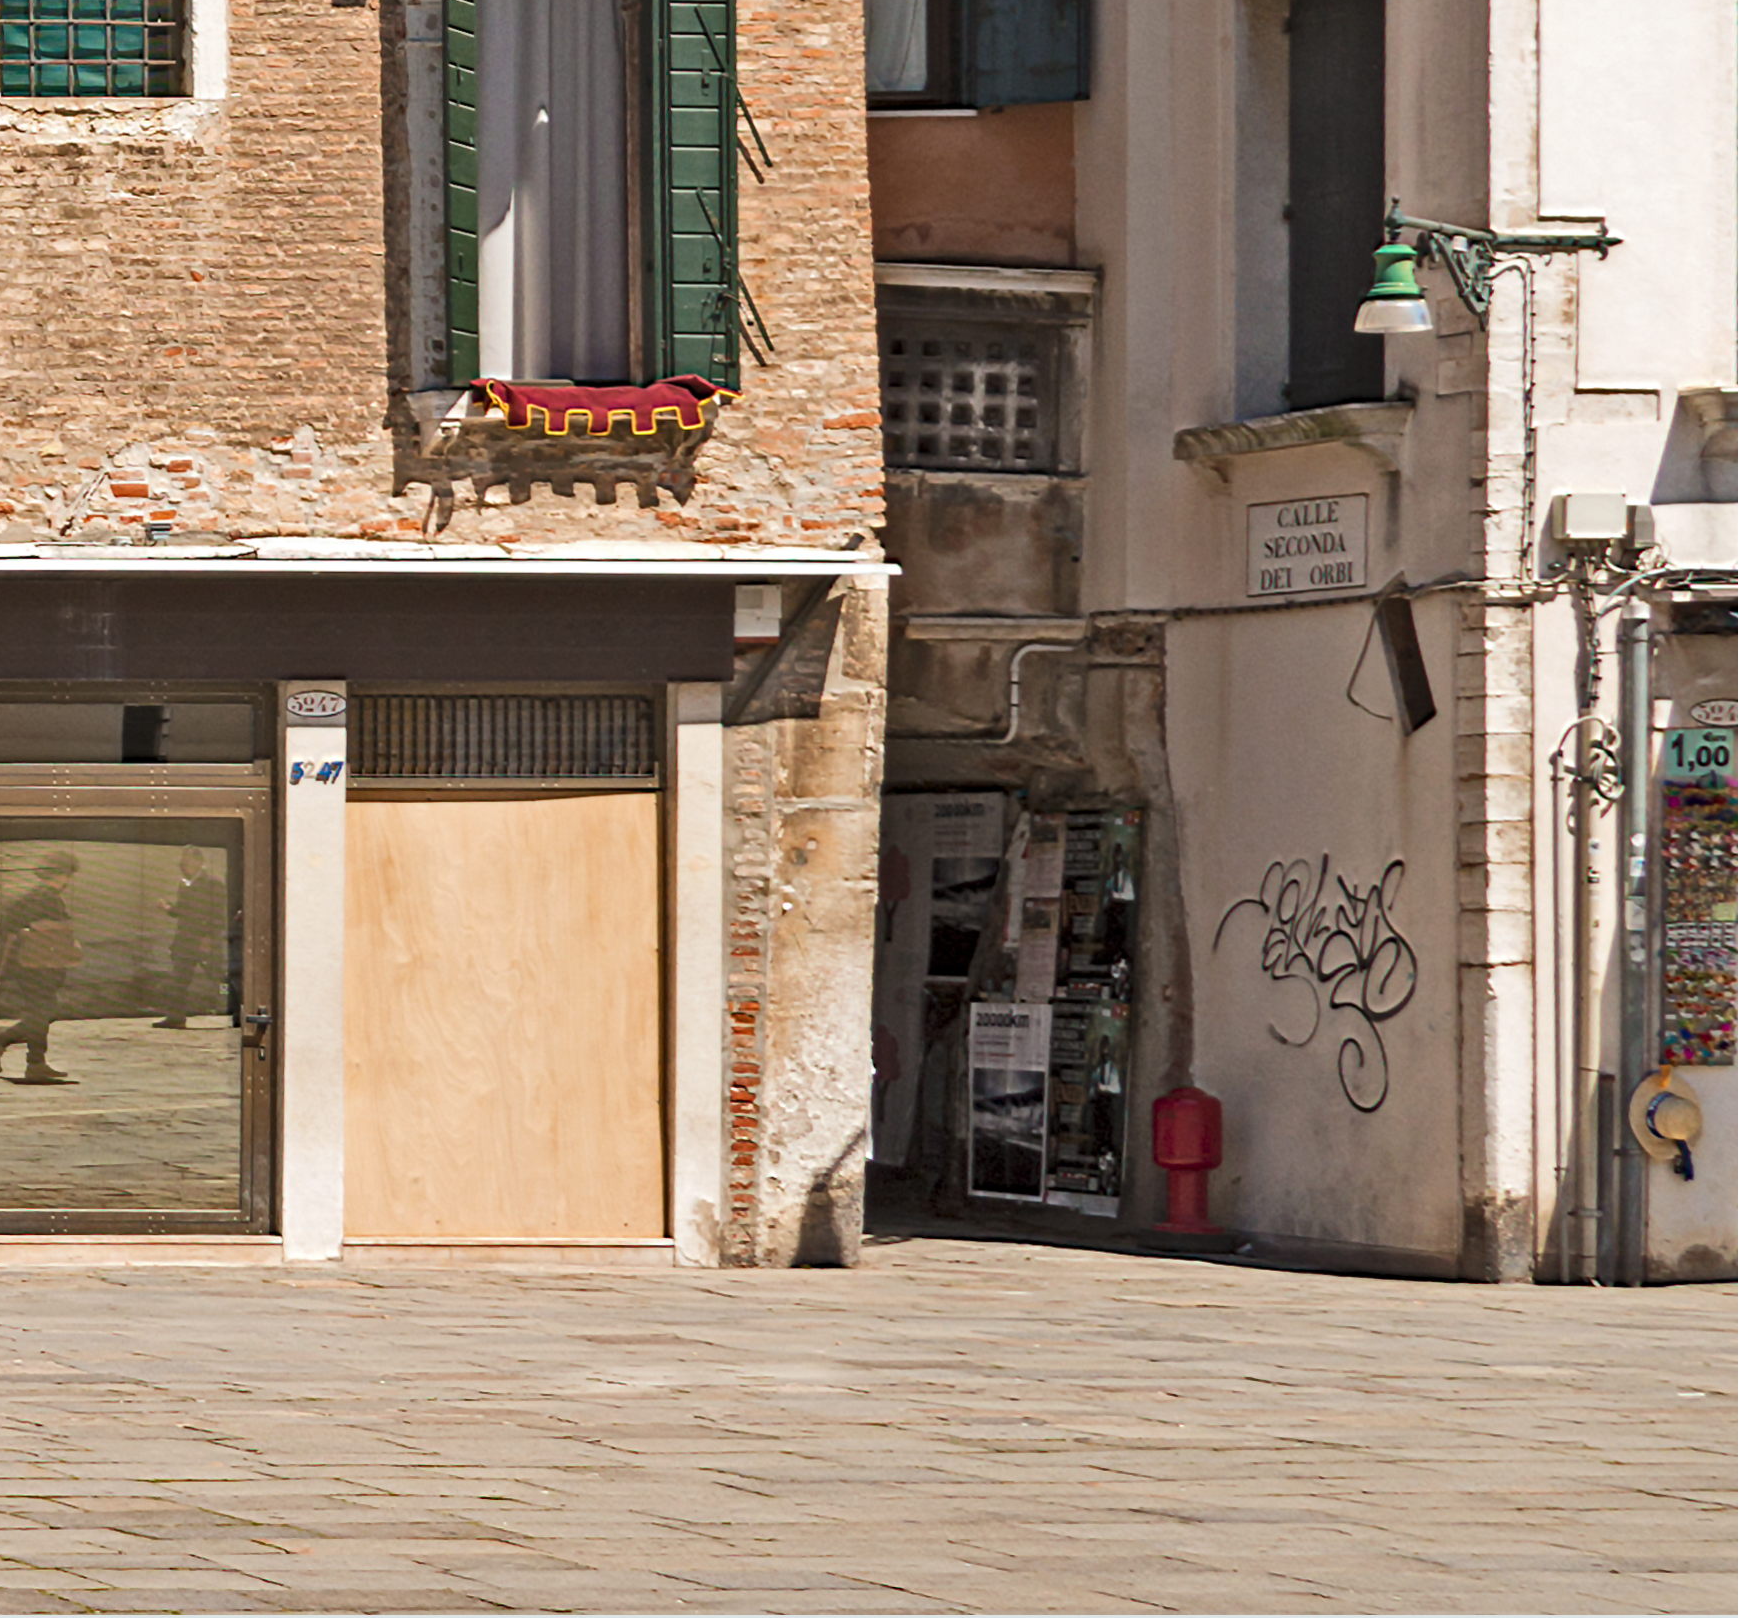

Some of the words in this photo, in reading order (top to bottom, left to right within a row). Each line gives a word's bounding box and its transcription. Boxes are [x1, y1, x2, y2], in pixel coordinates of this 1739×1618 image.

[1277, 501, 1339, 528] CALLE
[1264, 532, 1347, 558] SECONDA
[1260, 567, 1292, 591] DEI
[1310, 561, 1354, 585] ORBI
[292, 695, 340, 712] 5247
[1697, 704, 1737, 721] 524
[1671, 733, 1730, 772] 1,00
[289, 761, 344, 785] 5247
